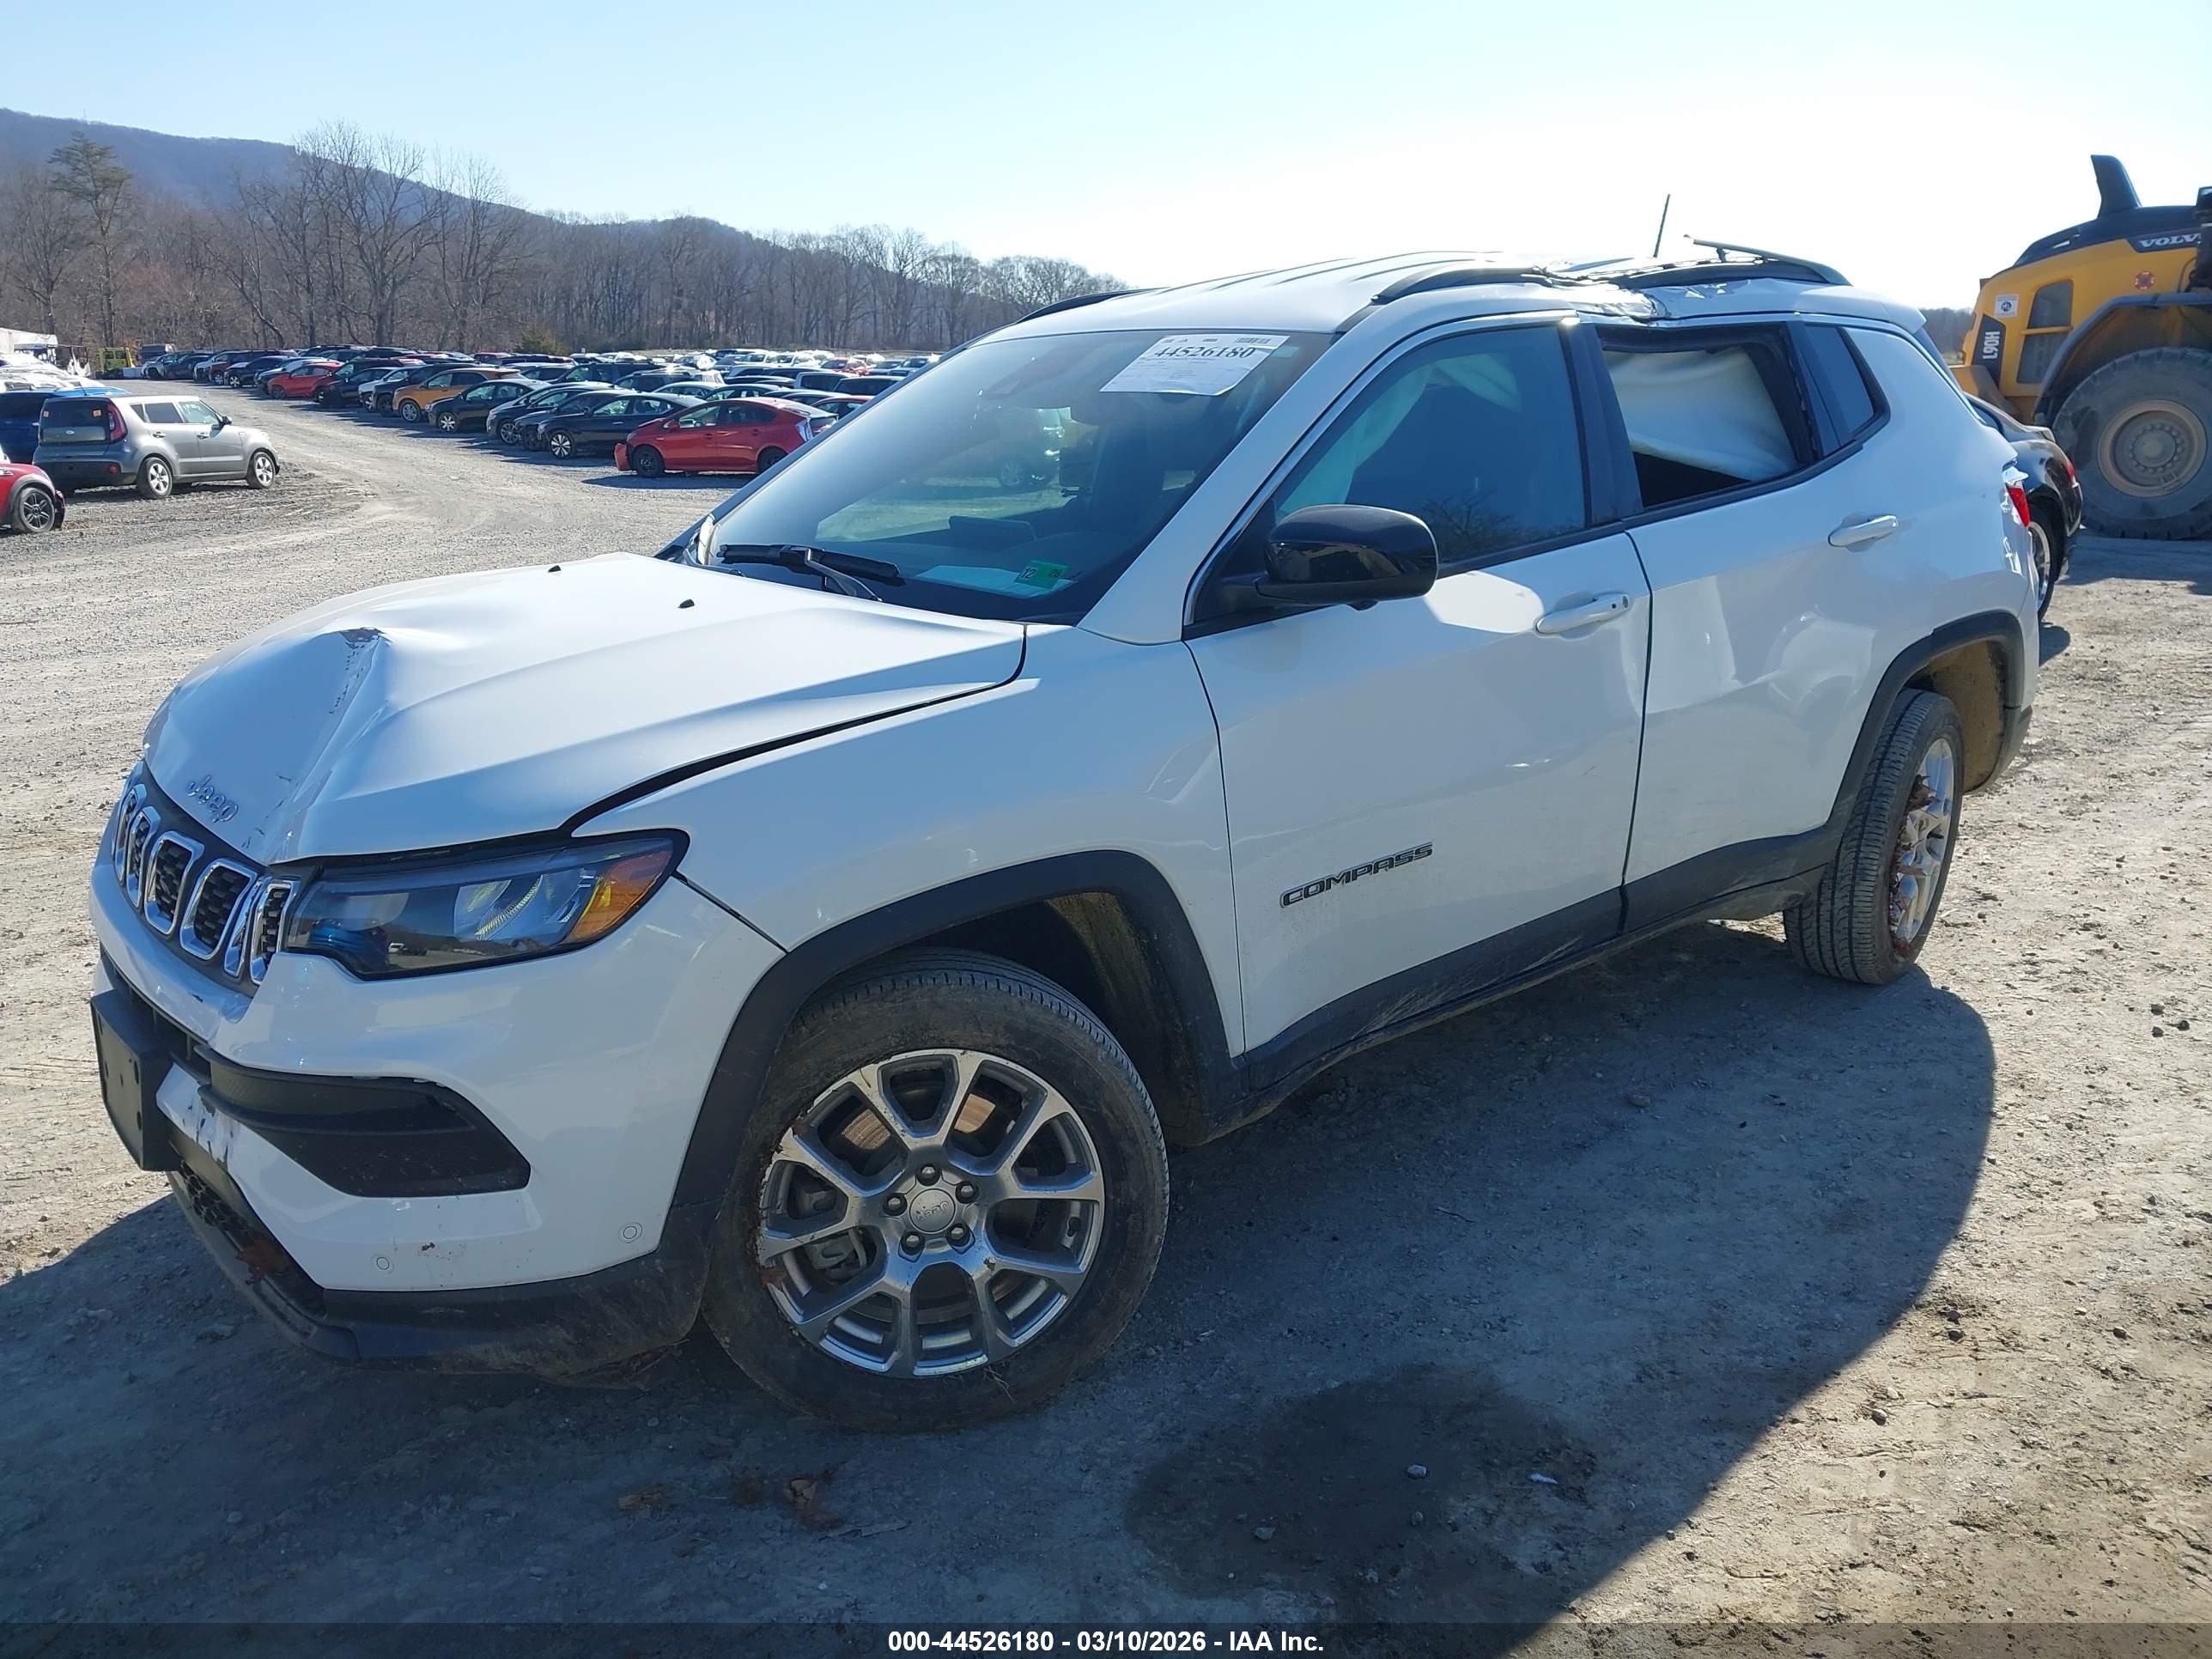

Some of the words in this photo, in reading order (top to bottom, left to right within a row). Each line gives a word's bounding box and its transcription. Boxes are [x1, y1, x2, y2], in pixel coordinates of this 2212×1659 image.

[2139, 233, 2201, 246] VOLV
[1154, 346, 1256, 359] 44526180
[1983, 331, 2000, 359] L90H
[1021, 568, 1036, 579] 12
[187, 775, 239, 823] Jeep
[1279, 841, 1433, 908] COMPASS
